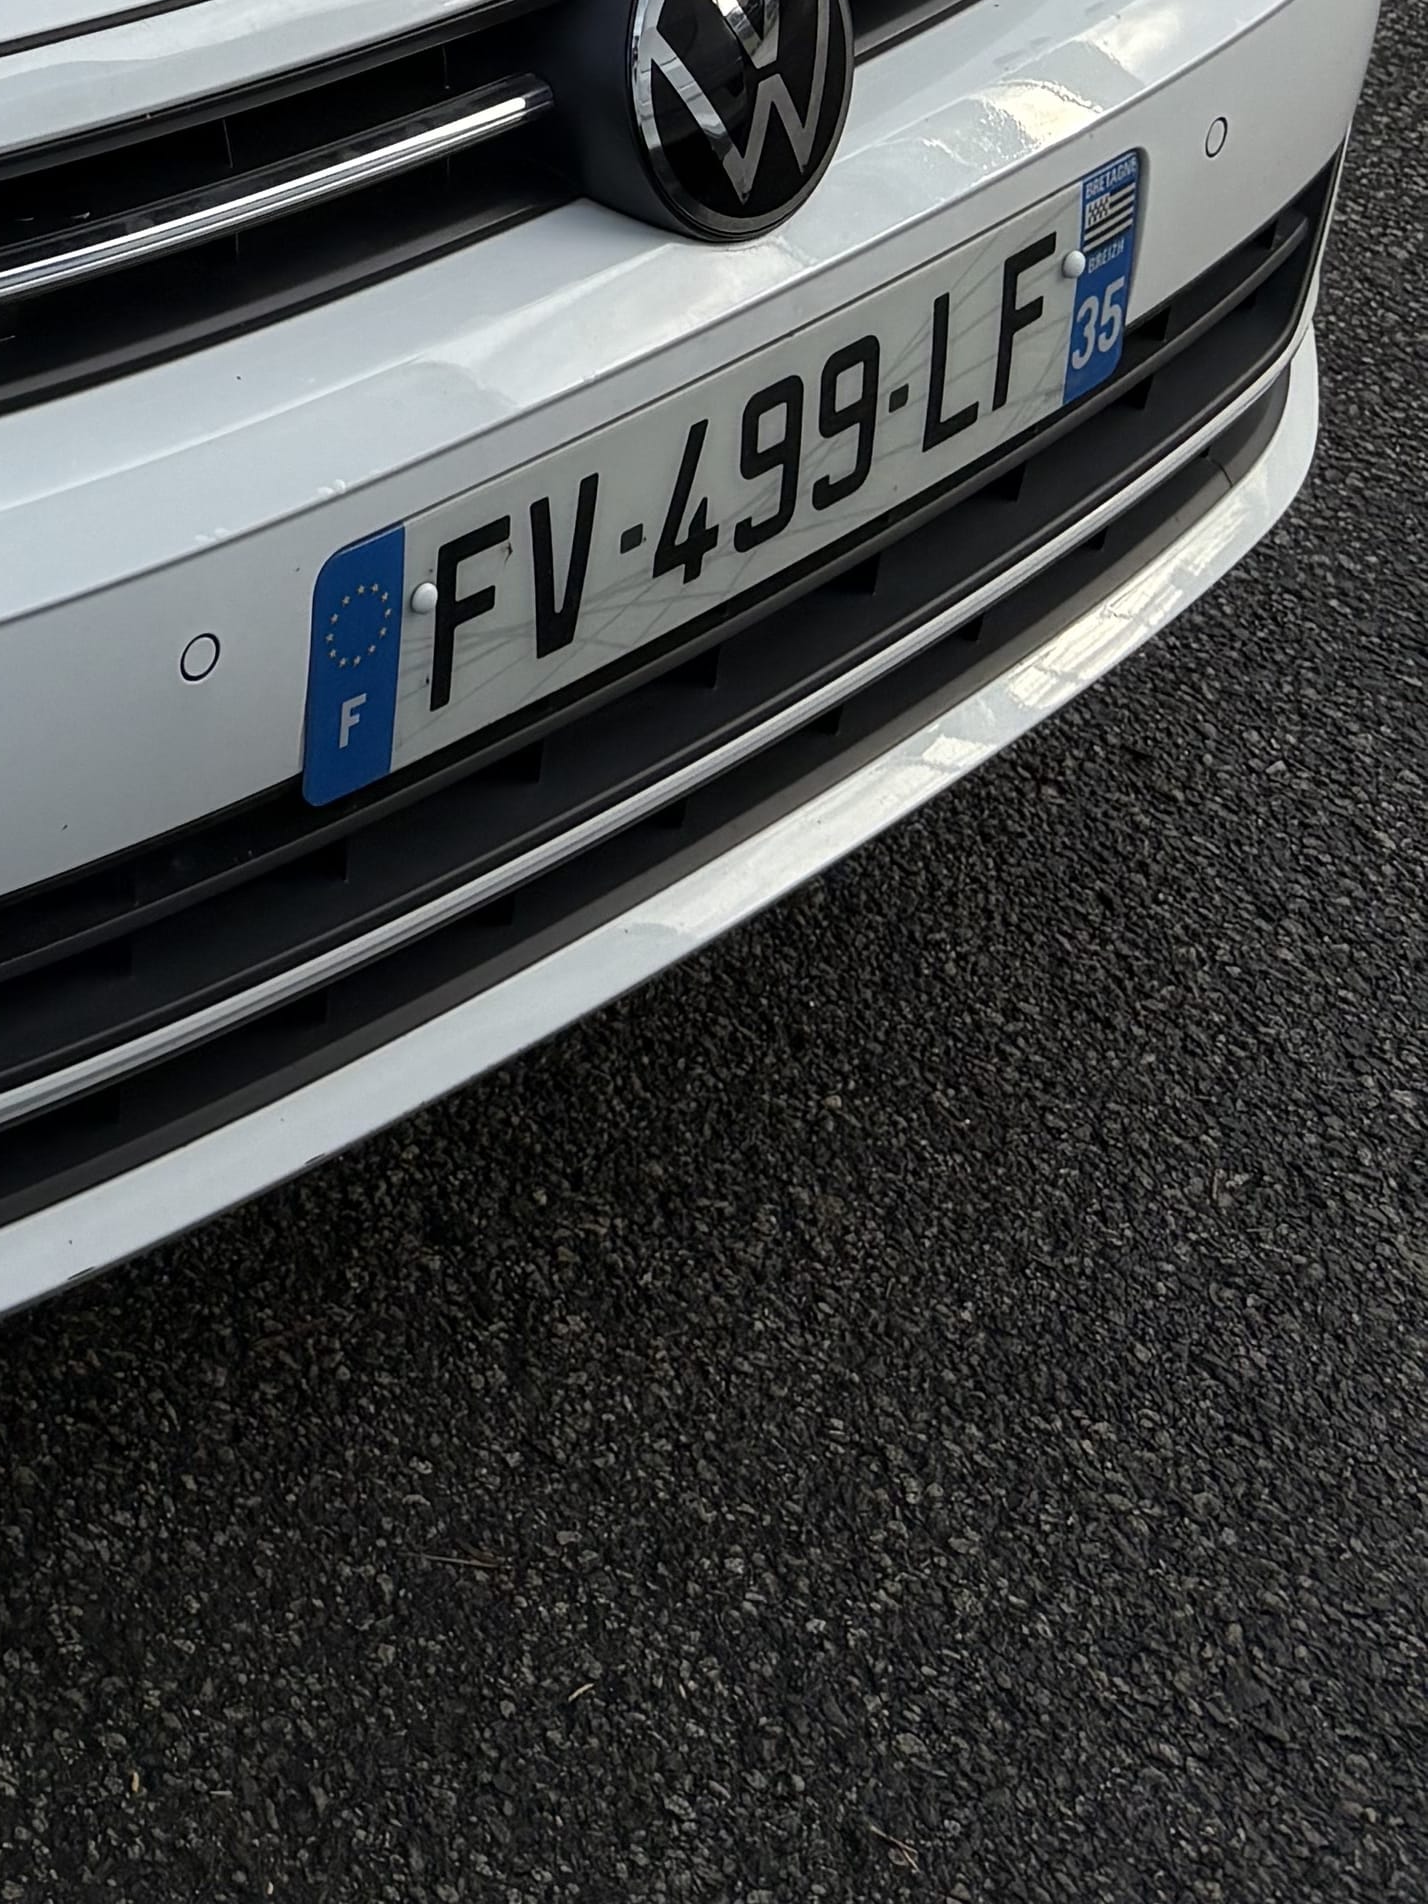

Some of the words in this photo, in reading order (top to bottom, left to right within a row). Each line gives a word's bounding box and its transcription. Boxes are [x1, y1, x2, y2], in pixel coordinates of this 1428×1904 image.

[1087, 239, 1125, 275] BREIZH
[1071, 275, 1126, 370] 35
[429, 231, 1057, 712] FV-499-LF
[338, 693, 367, 749] F
